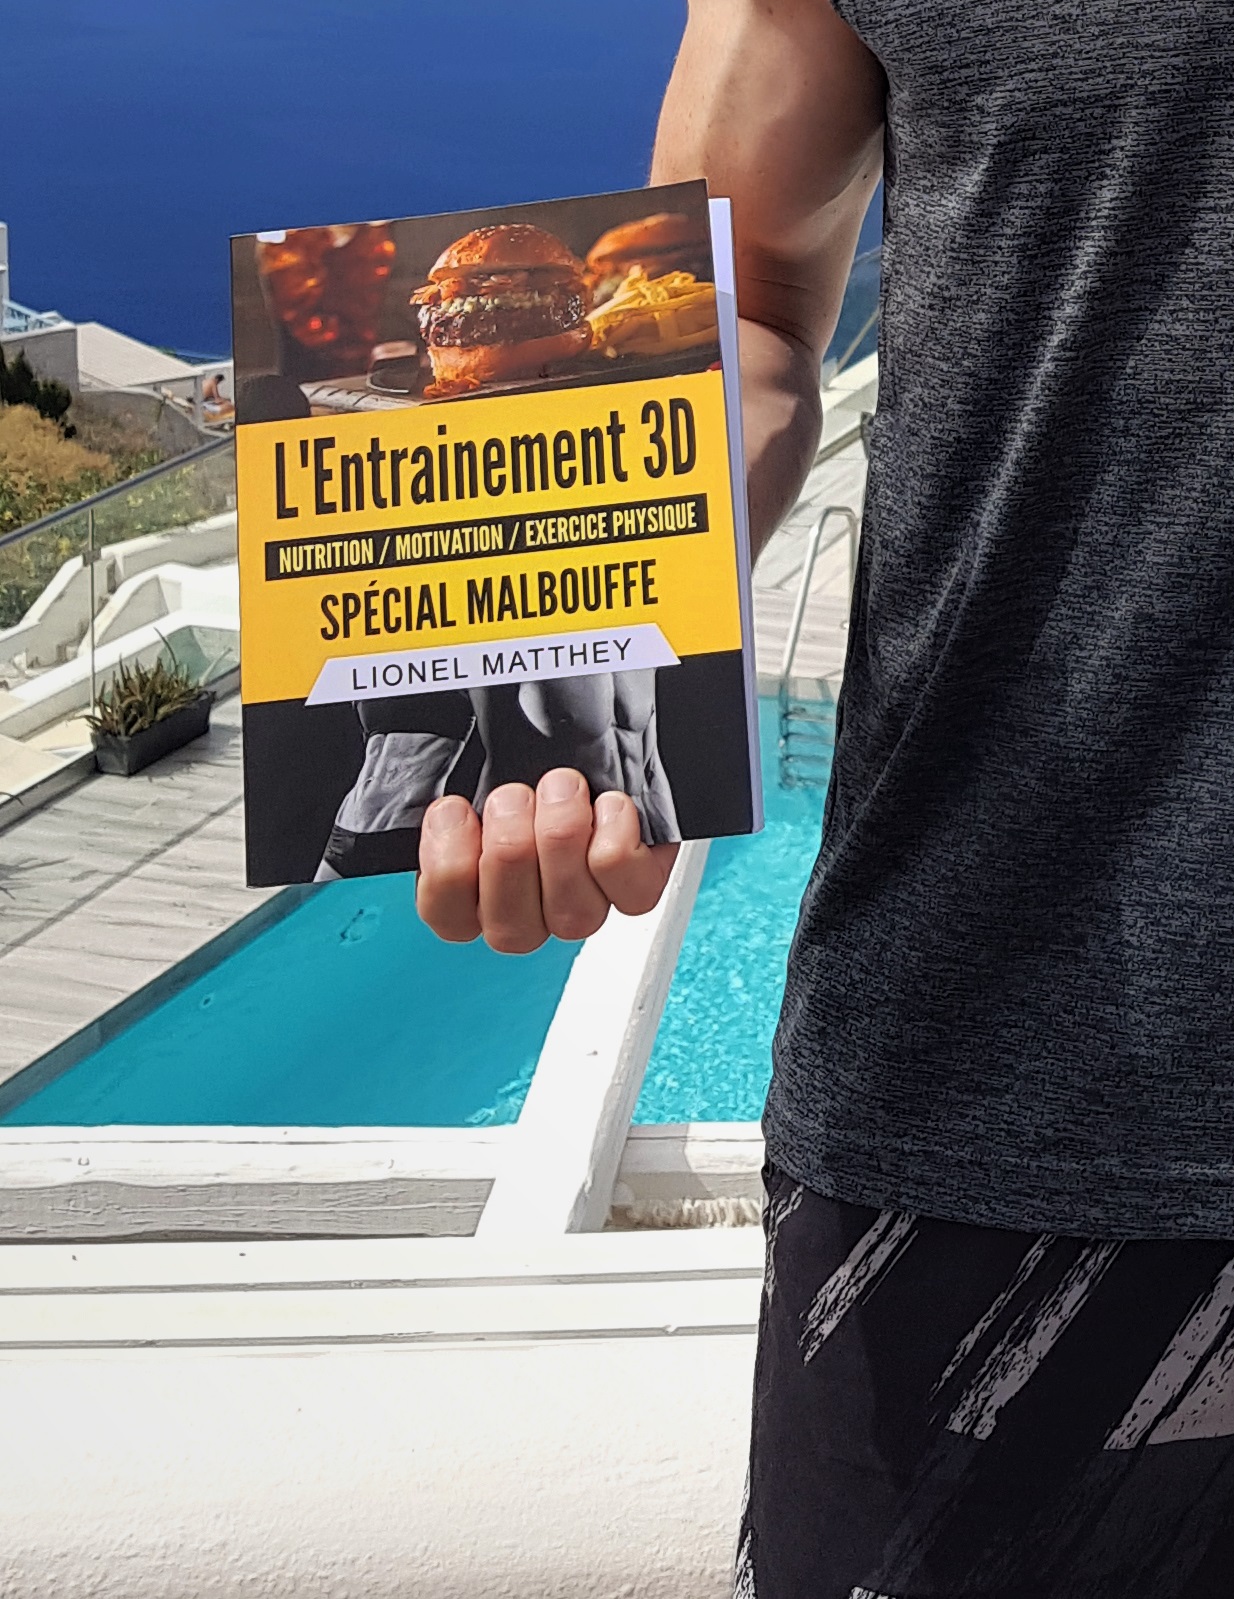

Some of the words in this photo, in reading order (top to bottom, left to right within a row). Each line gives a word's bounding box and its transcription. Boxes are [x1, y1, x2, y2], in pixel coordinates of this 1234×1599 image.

[275, 410, 628, 520] L'Entrainement
[641, 397, 697, 479] 3D
[278, 539, 374, 574] NUTRITION
[378, 538, 390, 565] /
[395, 524, 504, 561] MOTIVATION
[508, 521, 520, 551] /
[525, 511, 608, 547] EXERCICE
[612, 501, 697, 537] PHYSIQUE
[320, 580, 457, 641] SPÉCIAL
[467, 558, 658, 624] MALBOUFFE
[352, 657, 468, 691] LIONEL
[483, 637, 632, 676] MATTHEY
